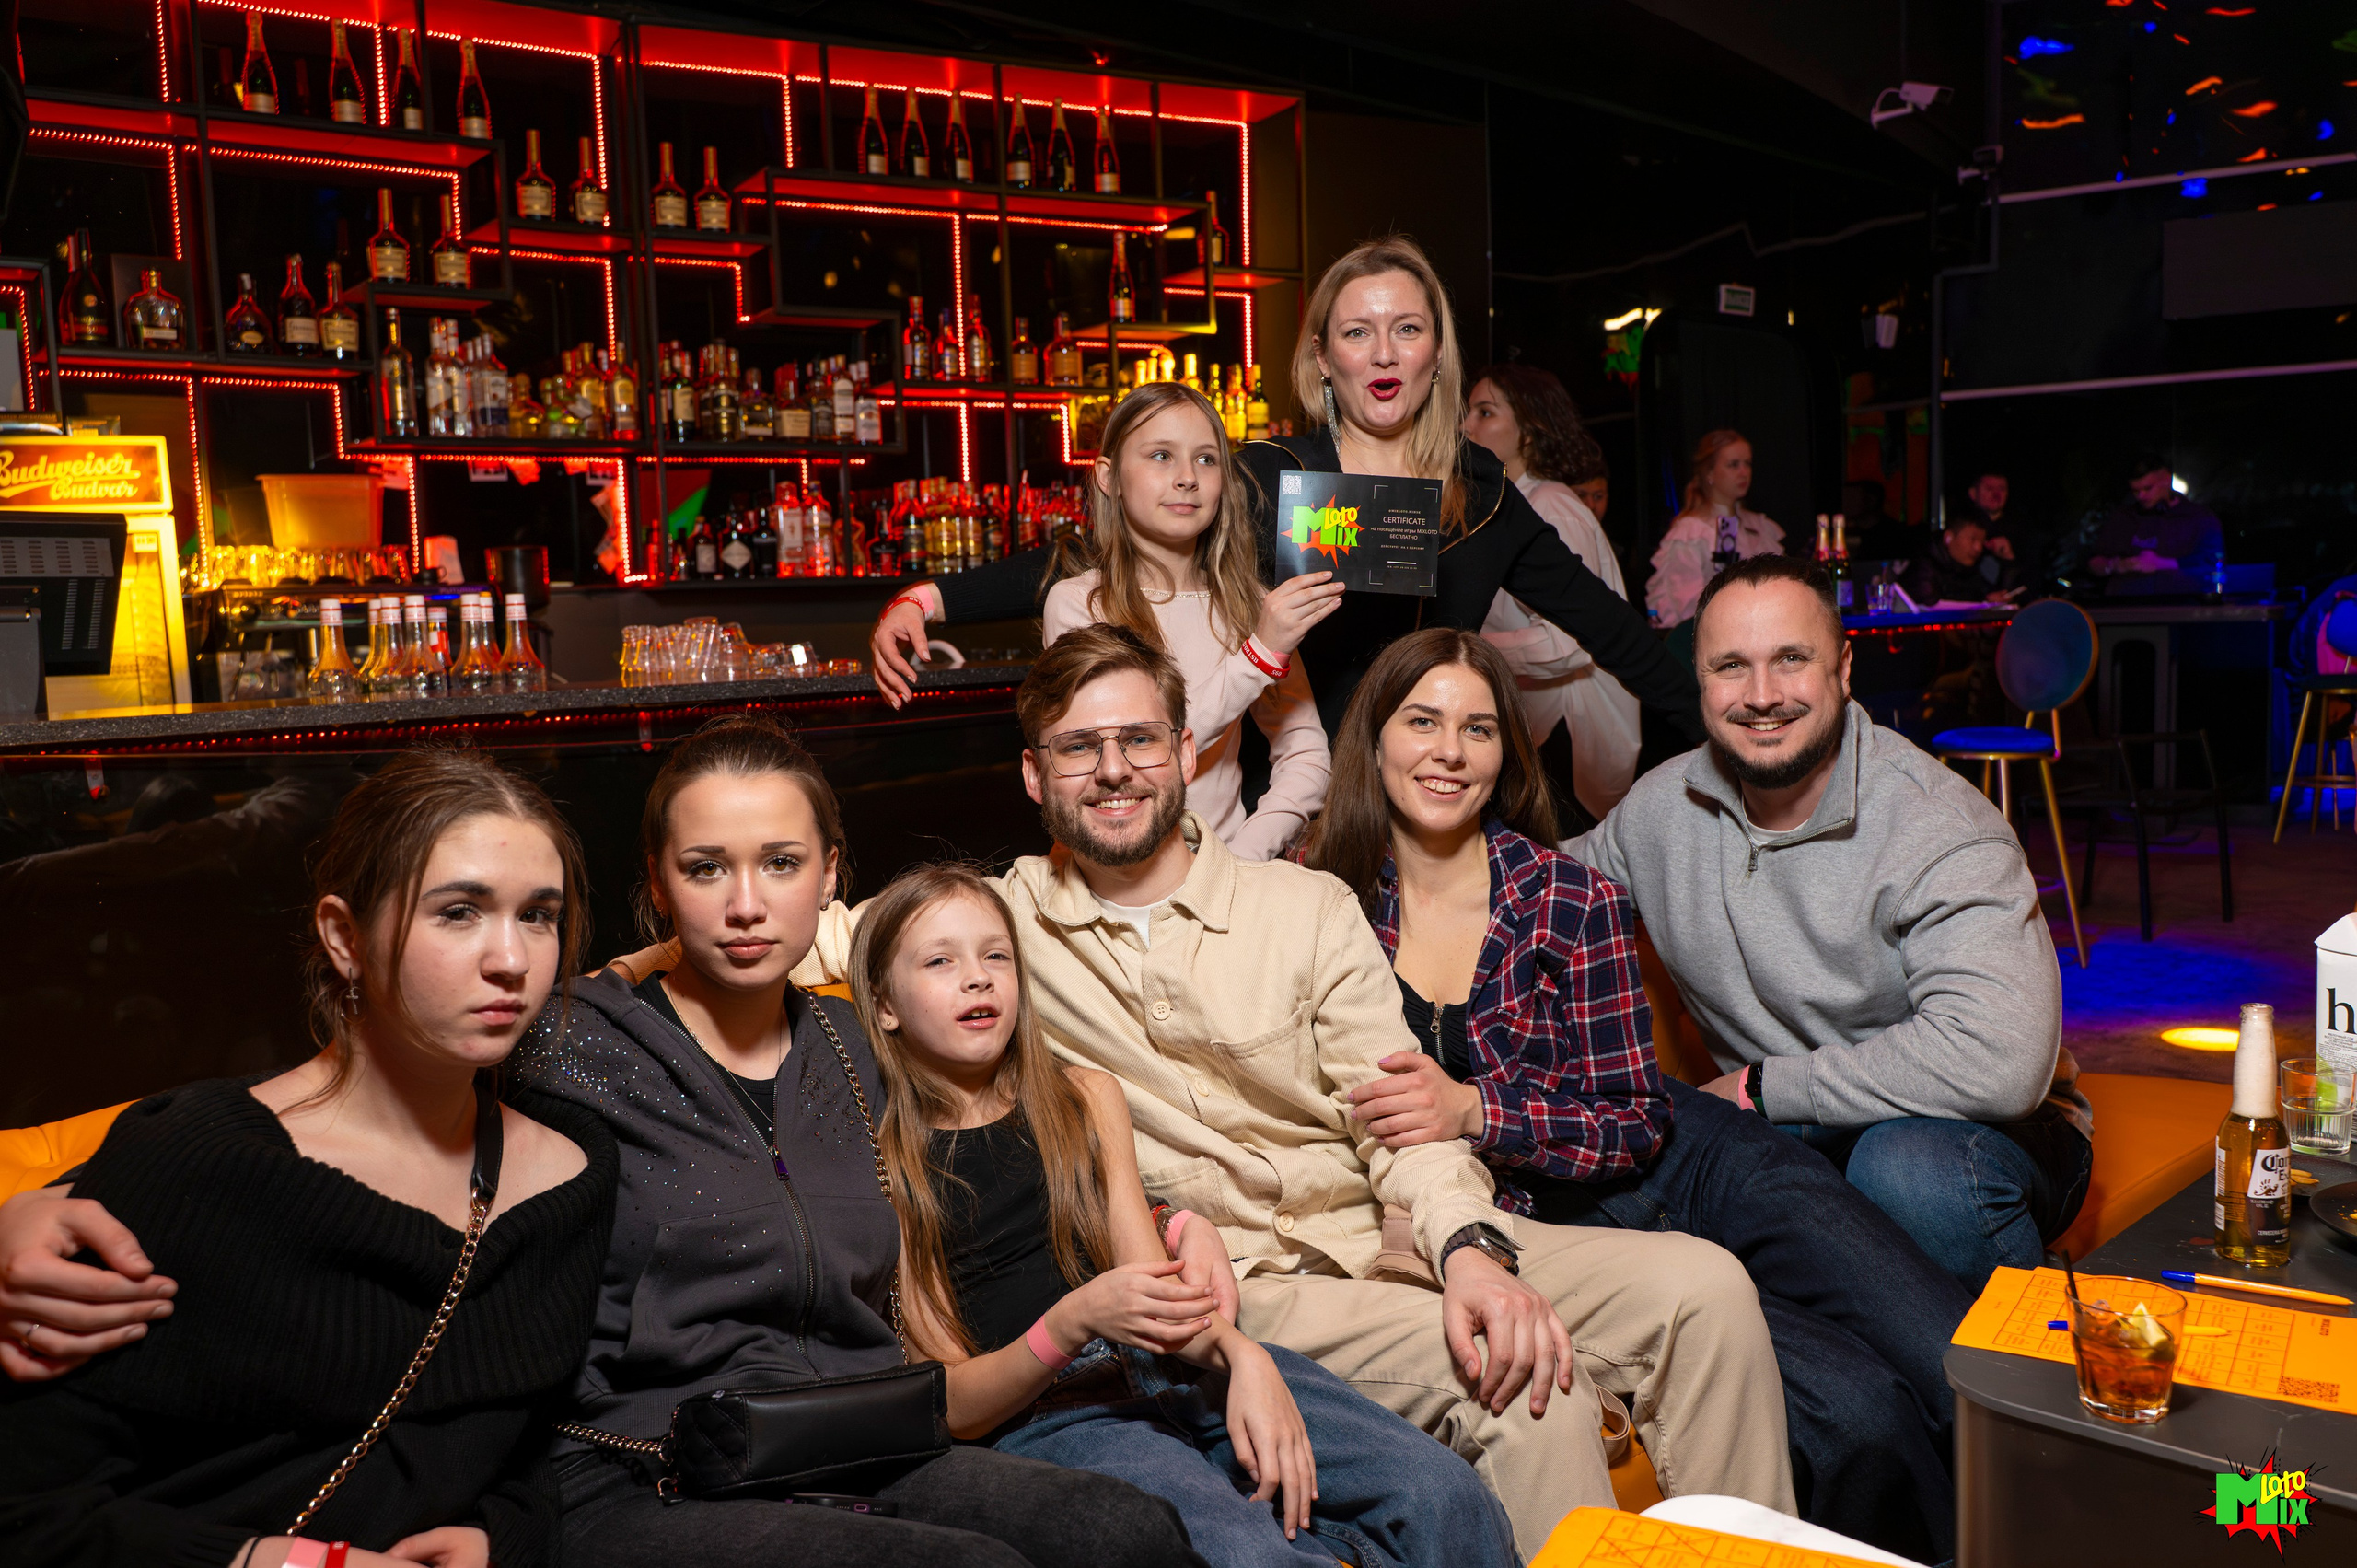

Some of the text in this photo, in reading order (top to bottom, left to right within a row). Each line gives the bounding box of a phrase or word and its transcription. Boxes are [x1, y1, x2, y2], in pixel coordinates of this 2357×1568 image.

[0, 450, 135, 487] Budweiser
[50, 475, 138, 500] Budvar
[1324, 506, 1357, 530] Loto
[1383, 517, 1425, 526] CERTIFICATE
